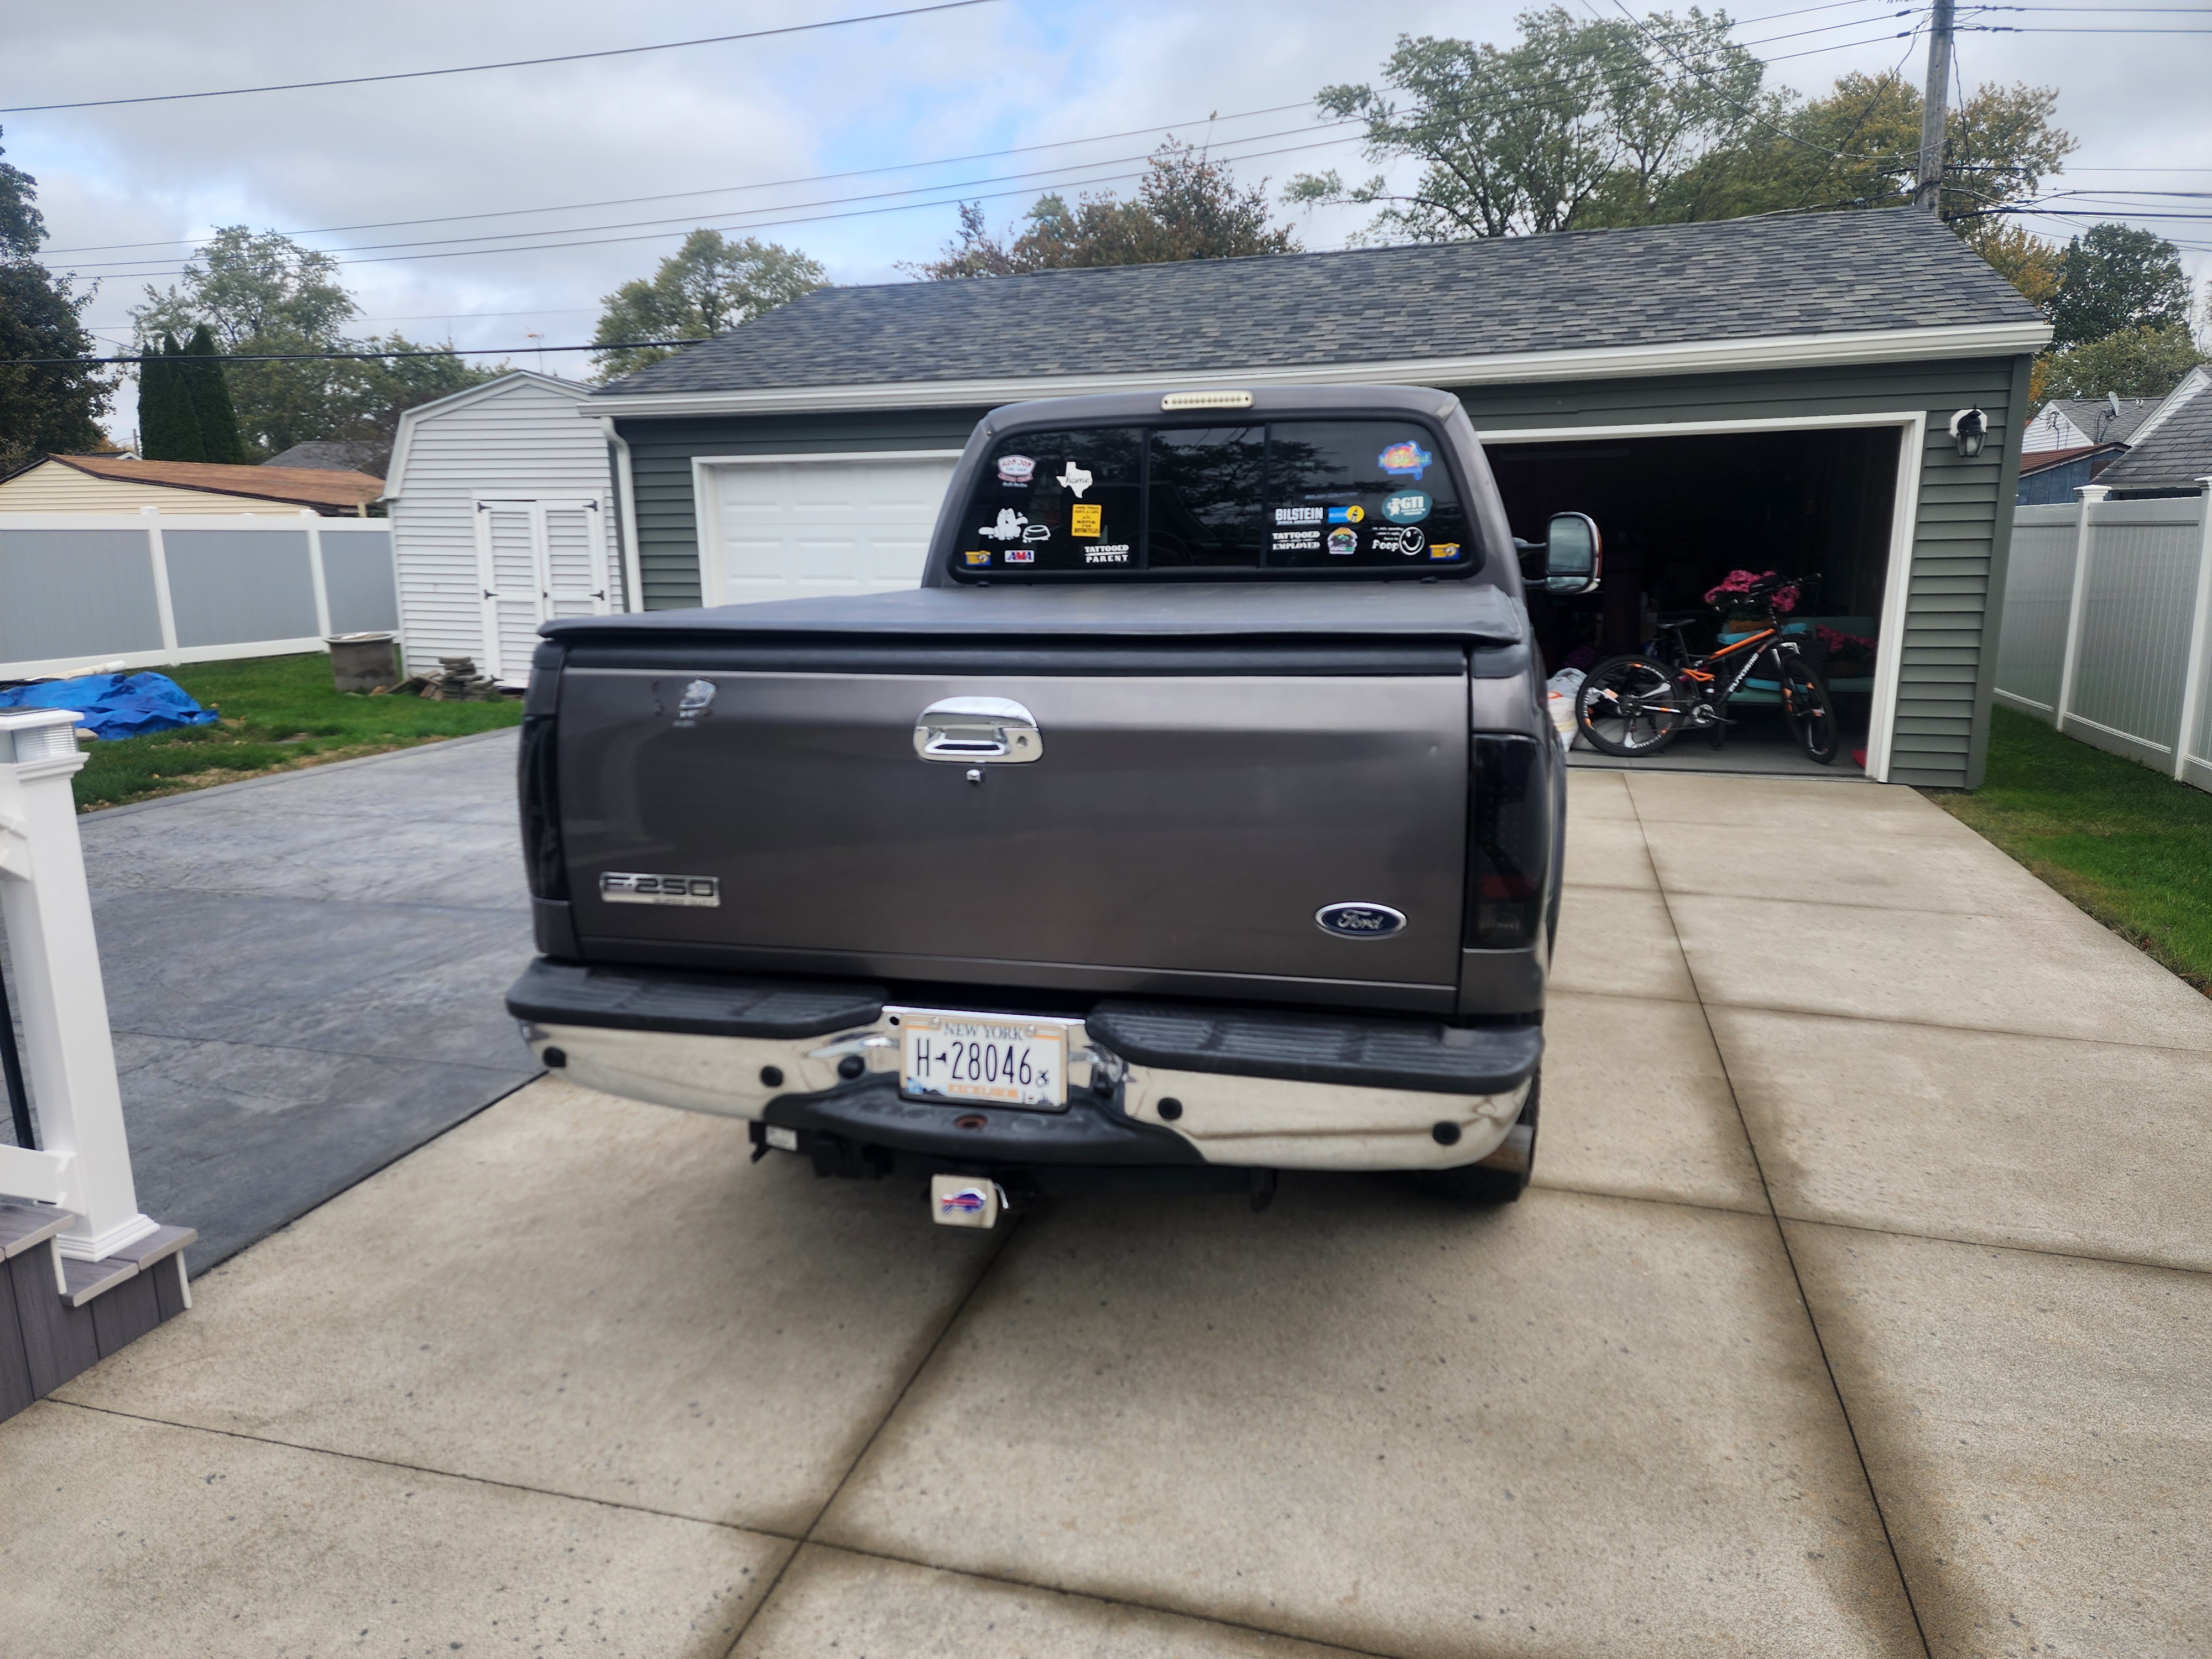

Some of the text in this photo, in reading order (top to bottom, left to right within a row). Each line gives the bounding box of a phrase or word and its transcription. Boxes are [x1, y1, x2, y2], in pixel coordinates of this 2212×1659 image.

[1066, 473, 1091, 483] home
[1275, 507, 1323, 521] BILSTEIN
[1272, 531, 1321, 540] TATTOOED
[1084, 544, 1129, 553] TATTOOED
[1272, 541, 1321, 550] EMPLOYED
[1372, 539, 1400, 552] Poop
[1008, 551, 1032, 561] AMA
[1086, 554, 1128, 563] PARENT
[1337, 909, 1384, 929] Ford
[945, 1023, 1023, 1040] NEW YORK
